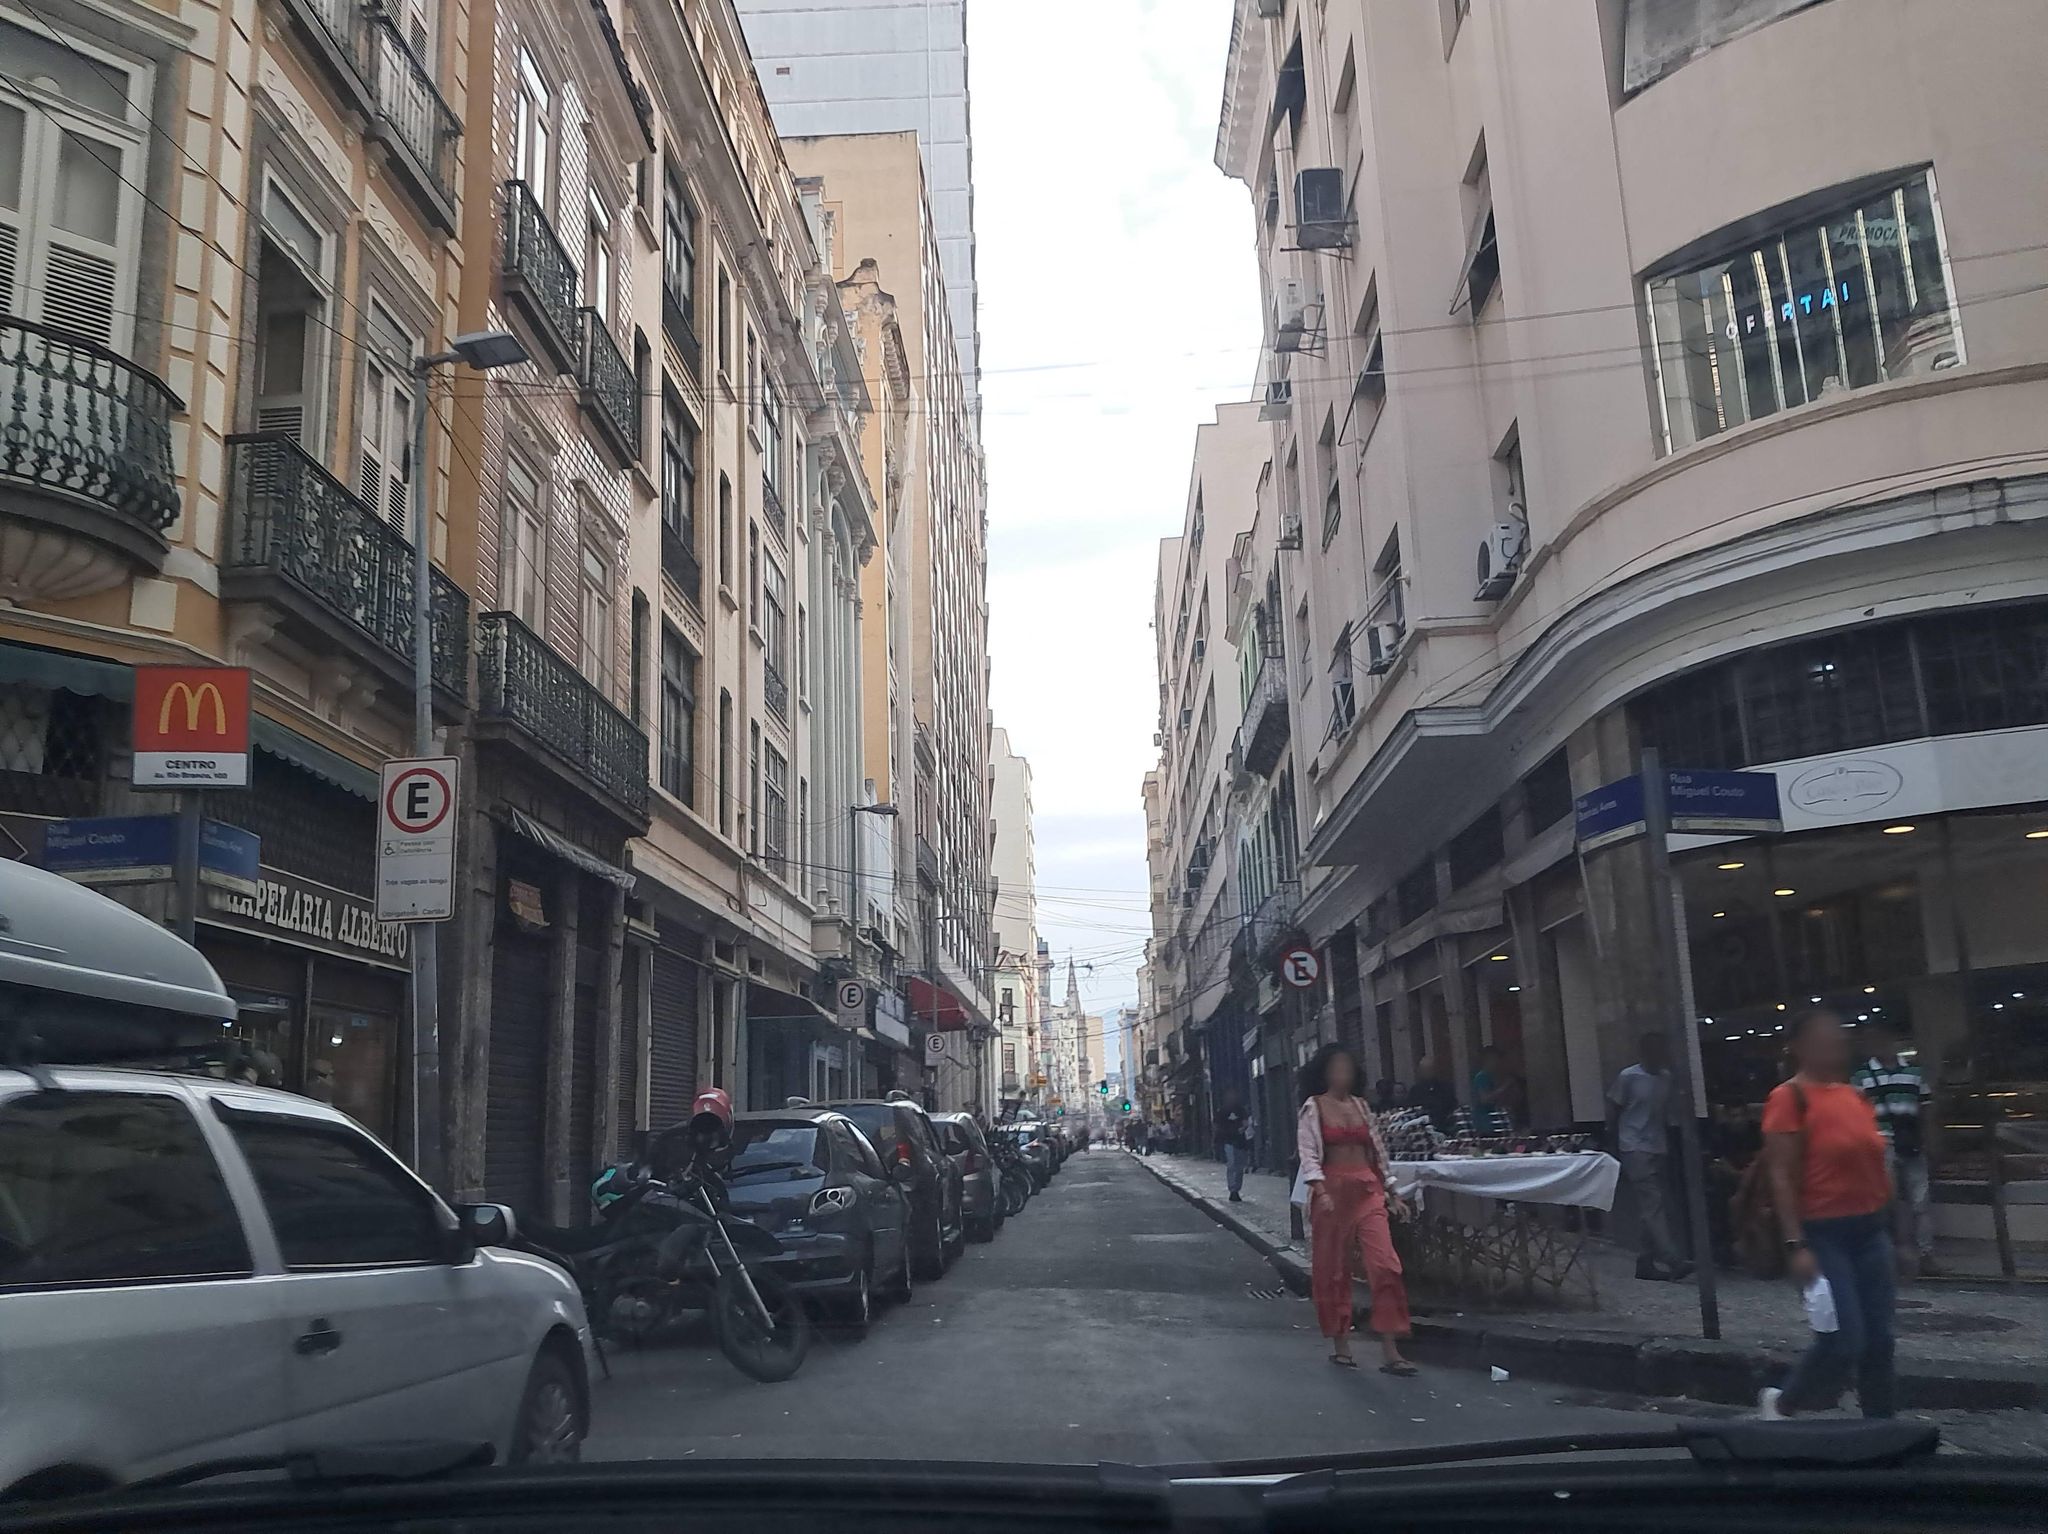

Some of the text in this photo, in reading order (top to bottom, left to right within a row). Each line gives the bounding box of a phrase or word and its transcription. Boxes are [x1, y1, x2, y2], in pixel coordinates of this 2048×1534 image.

[165, 759, 217, 770] CENTRO
[1670, 773, 1693, 784] Rua
[1671, 785, 1745, 799] Miguel Couto
[406, 781, 431, 820] E
[88, 833, 126, 845] Couto
[338, 904, 408, 960] ALBERTO
[846, 987, 857, 1004] E
[932, 1037, 940, 1049] E
